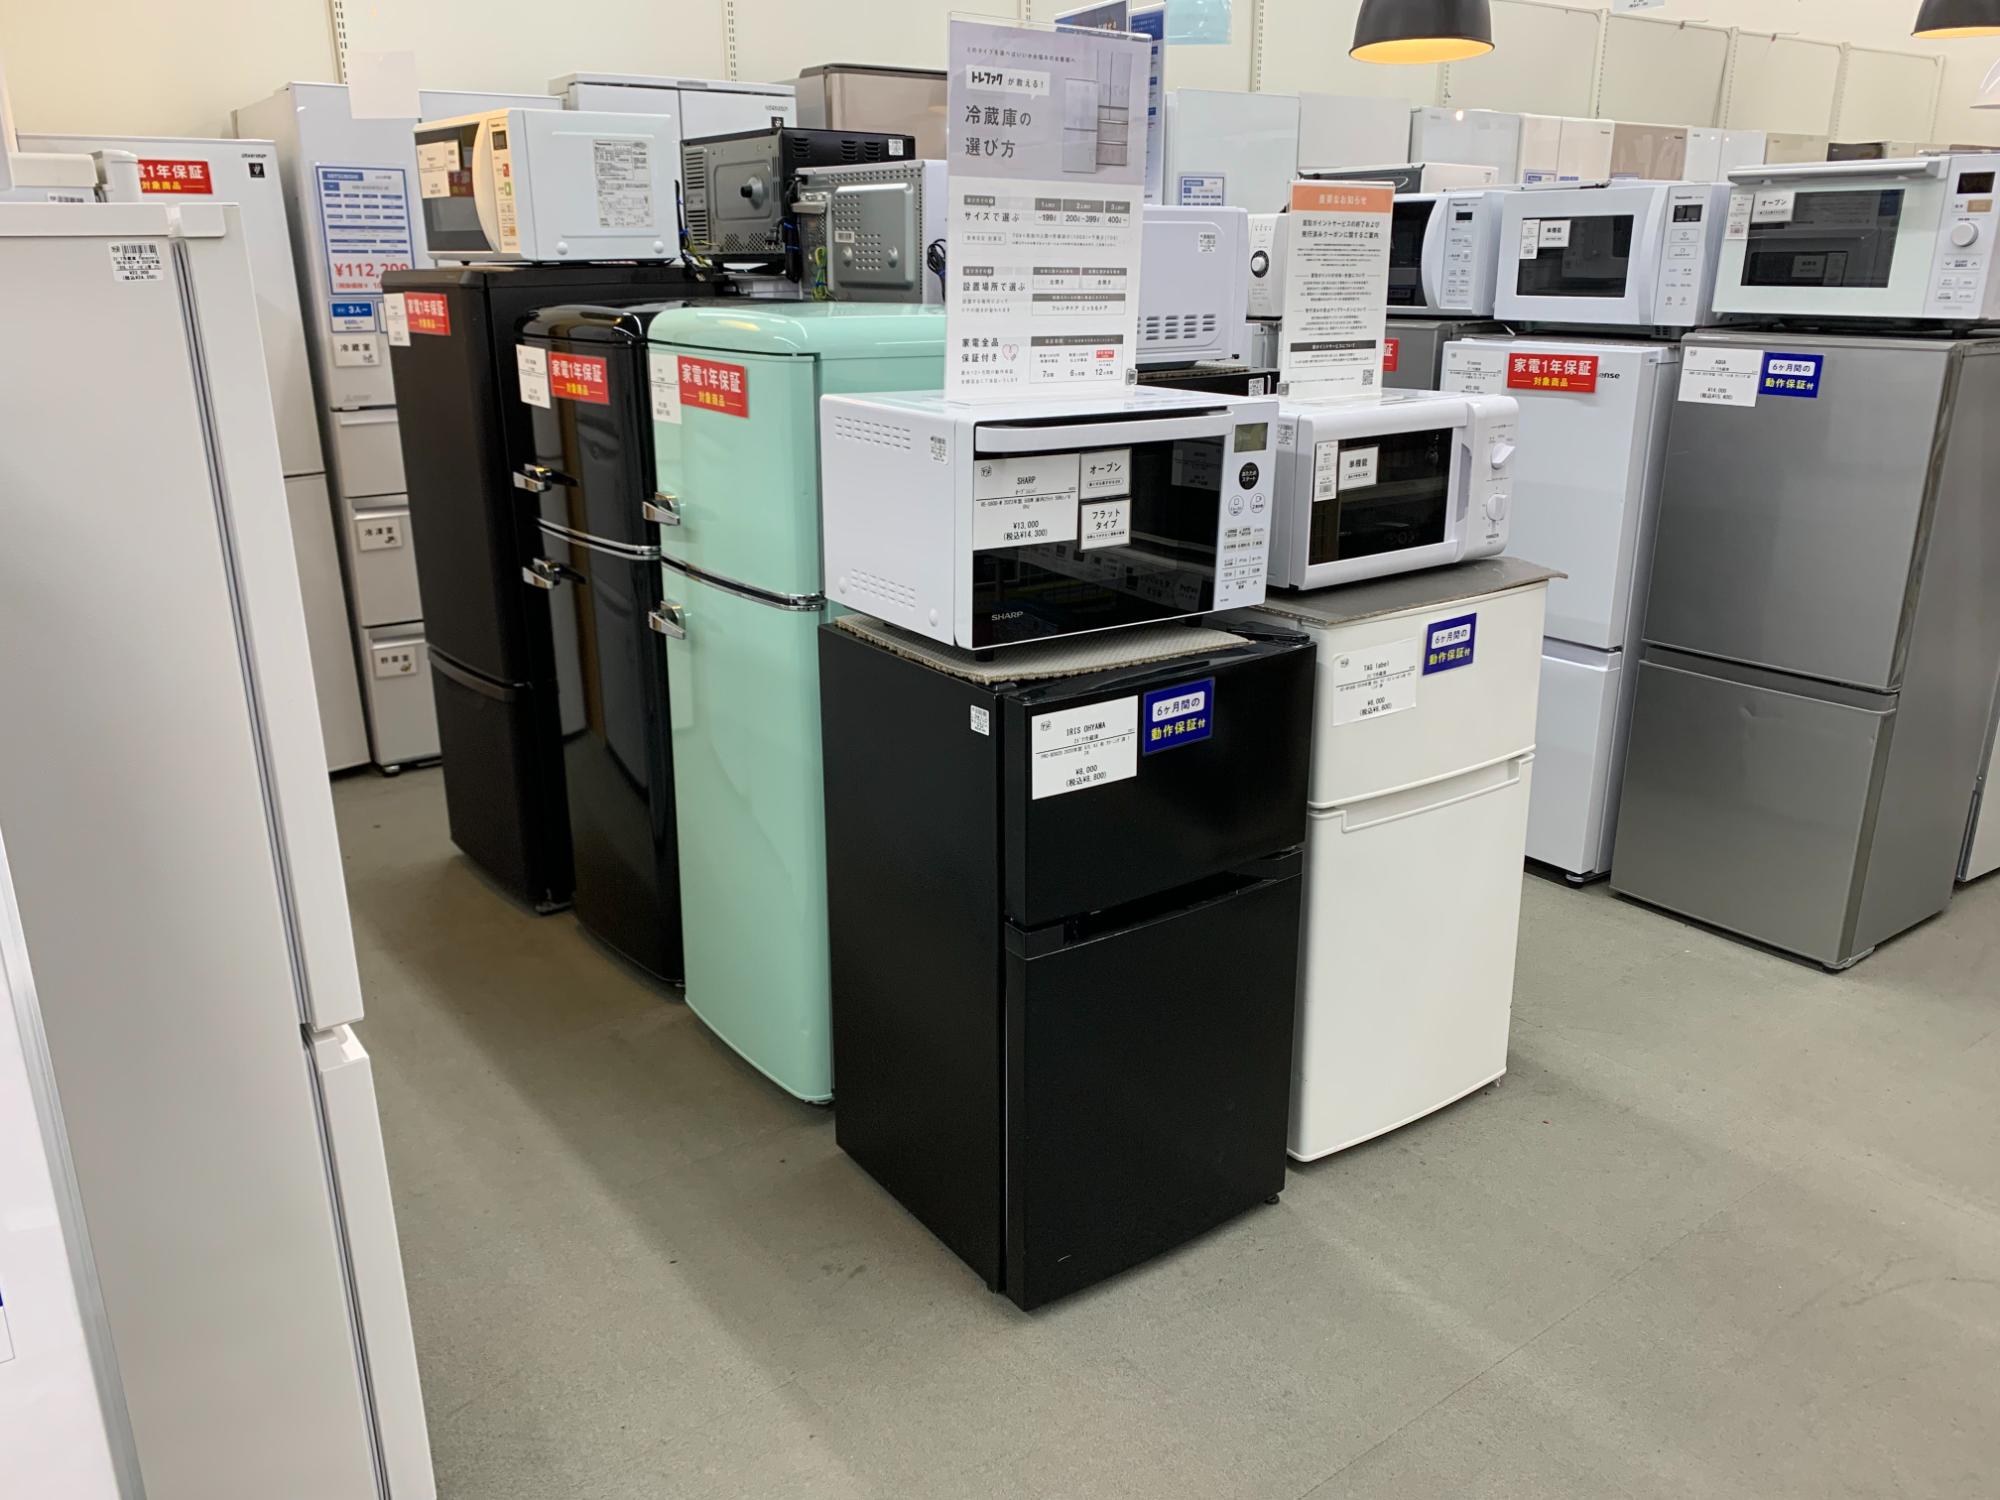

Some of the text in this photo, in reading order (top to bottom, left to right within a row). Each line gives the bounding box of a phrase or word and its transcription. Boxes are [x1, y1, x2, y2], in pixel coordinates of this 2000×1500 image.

[971, 71, 1003, 85] トレファク
[965, 104, 1032, 128] 冷蔵庫の
[965, 137, 1015, 159] 選び方
[964, 211, 1020, 224] サイズで選ぶ
[963, 281, 1026, 292] 設置場所で選ぶ
[961, 337, 999, 348] 家電全品
[961, 353, 999, 363] 保証付き
[552, 359, 603, 383] 家電1年保証
[1514, 358, 1593, 376] 家電1年保証
[681, 363, 742, 394] 家電1年保証
[1532, 376, 1569, 388] 対象商品
[1765, 377, 1815, 391] 動作保証付
[1089, 462, 1122, 475] オーブン
[1016, 475, 1037, 486] SHARP
[1092, 508, 1121, 520] フラット
[1013, 520, 1040, 530] ¥13,000
[1095, 520, 1118, 531] タイプ
[1003, 529, 1049, 541] (税込¥14,300)
[991, 610, 1024, 622] SHARP
[1428, 646, 1471, 666] 動作保証付
[1066, 720, 1107, 737] IRIS OHYAMA
[1150, 718, 1207, 741] 動作保証付
[1075, 764, 1098, 777] ¥8,000
